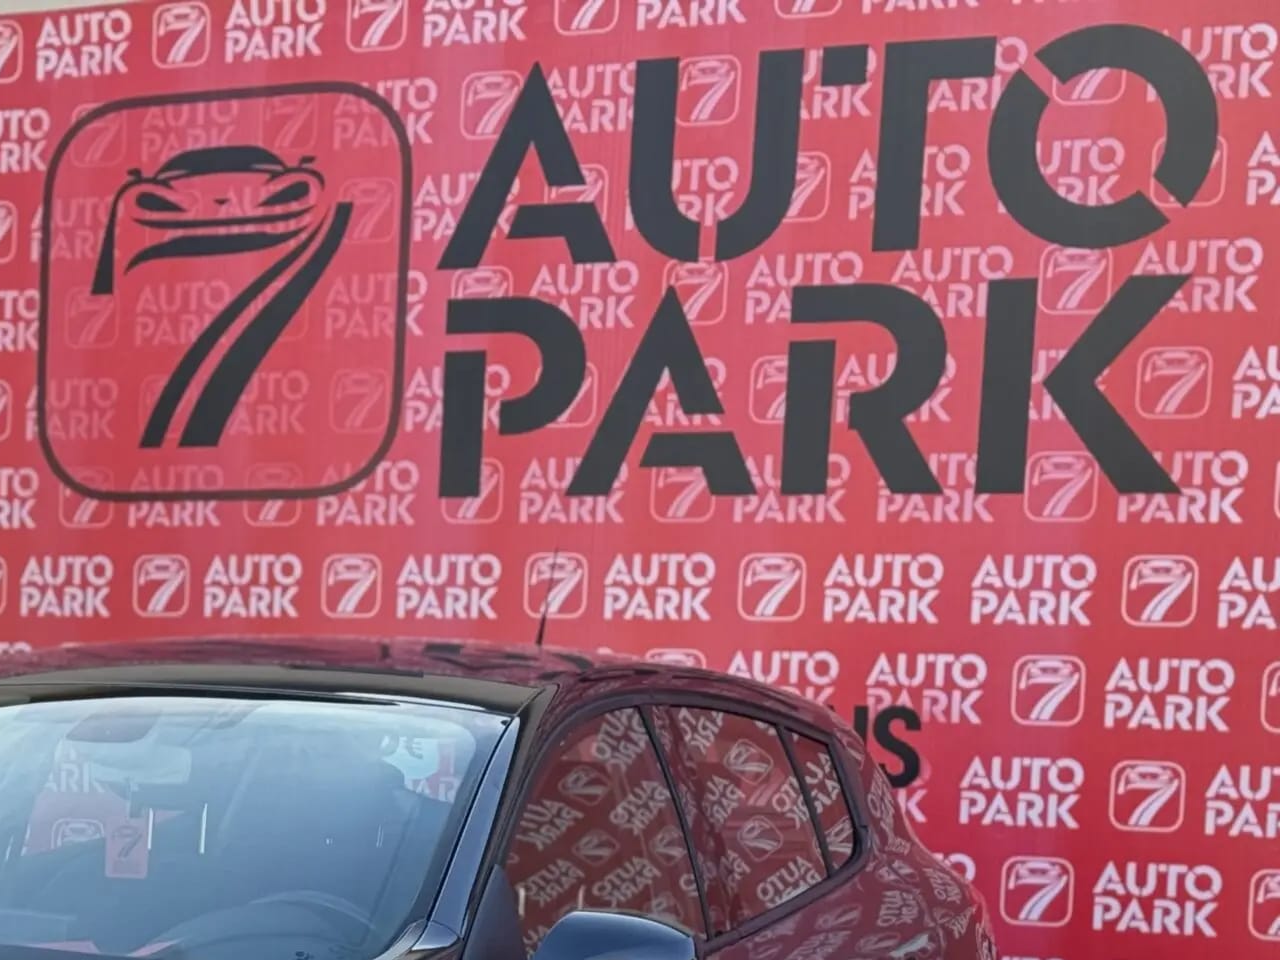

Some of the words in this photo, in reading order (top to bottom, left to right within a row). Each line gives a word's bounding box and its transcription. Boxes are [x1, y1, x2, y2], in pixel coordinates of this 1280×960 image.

[37, 10, 132, 48] AUTO
[225, 0, 326, 29] AUTO
[423, 10, 527, 47] PARK
[637, 0, 746, 30] PARK
[225, 22, 323, 63] PARK
[37, 42, 128, 82] PARK
[438, 23, 1218, 268] AUTO
[746, 251, 863, 288] AUTO
[891, 246, 1013, 284] AUTO
[1131, 238, 1263, 275] AUTO
[529, 261, 639, 297] AUTO
[438, 273, 1191, 498] PARK
[317, 494, 414, 526] PARK
[520, 492, 624, 523] PARK
[734, 489, 845, 522] PARK
[877, 487, 993, 522] PARK
[1118, 488, 1243, 524] PARK
[20, 555, 113, 586] AUTO
[204, 553, 302, 585] AUTO
[397, 554, 502, 586] AUTO
[604, 552, 716, 586] AUTO
[824, 553, 944, 588] AUTO
[972, 554, 1097, 589] AUTO
[20, 584, 110, 618] PARK
[204, 585, 298, 618] PARK
[396, 586, 497, 619] PARK
[604, 586, 711, 621] PARK
[823, 586, 939, 624] PARK
[971, 589, 1092, 626] PARK
[728, 650, 839, 687] AUTO
[867, 653, 987, 688] AUTO
[1105, 657, 1235, 695] AUTO
[867, 688, 981, 726] PARK
[1104, 690, 1230, 732] PARK
[960, 756, 1084, 793] AUTO
[959, 790, 1079, 829] PARK
[1093, 861, 1222, 900] AUTO
[1092, 893, 1218, 937] PARK
